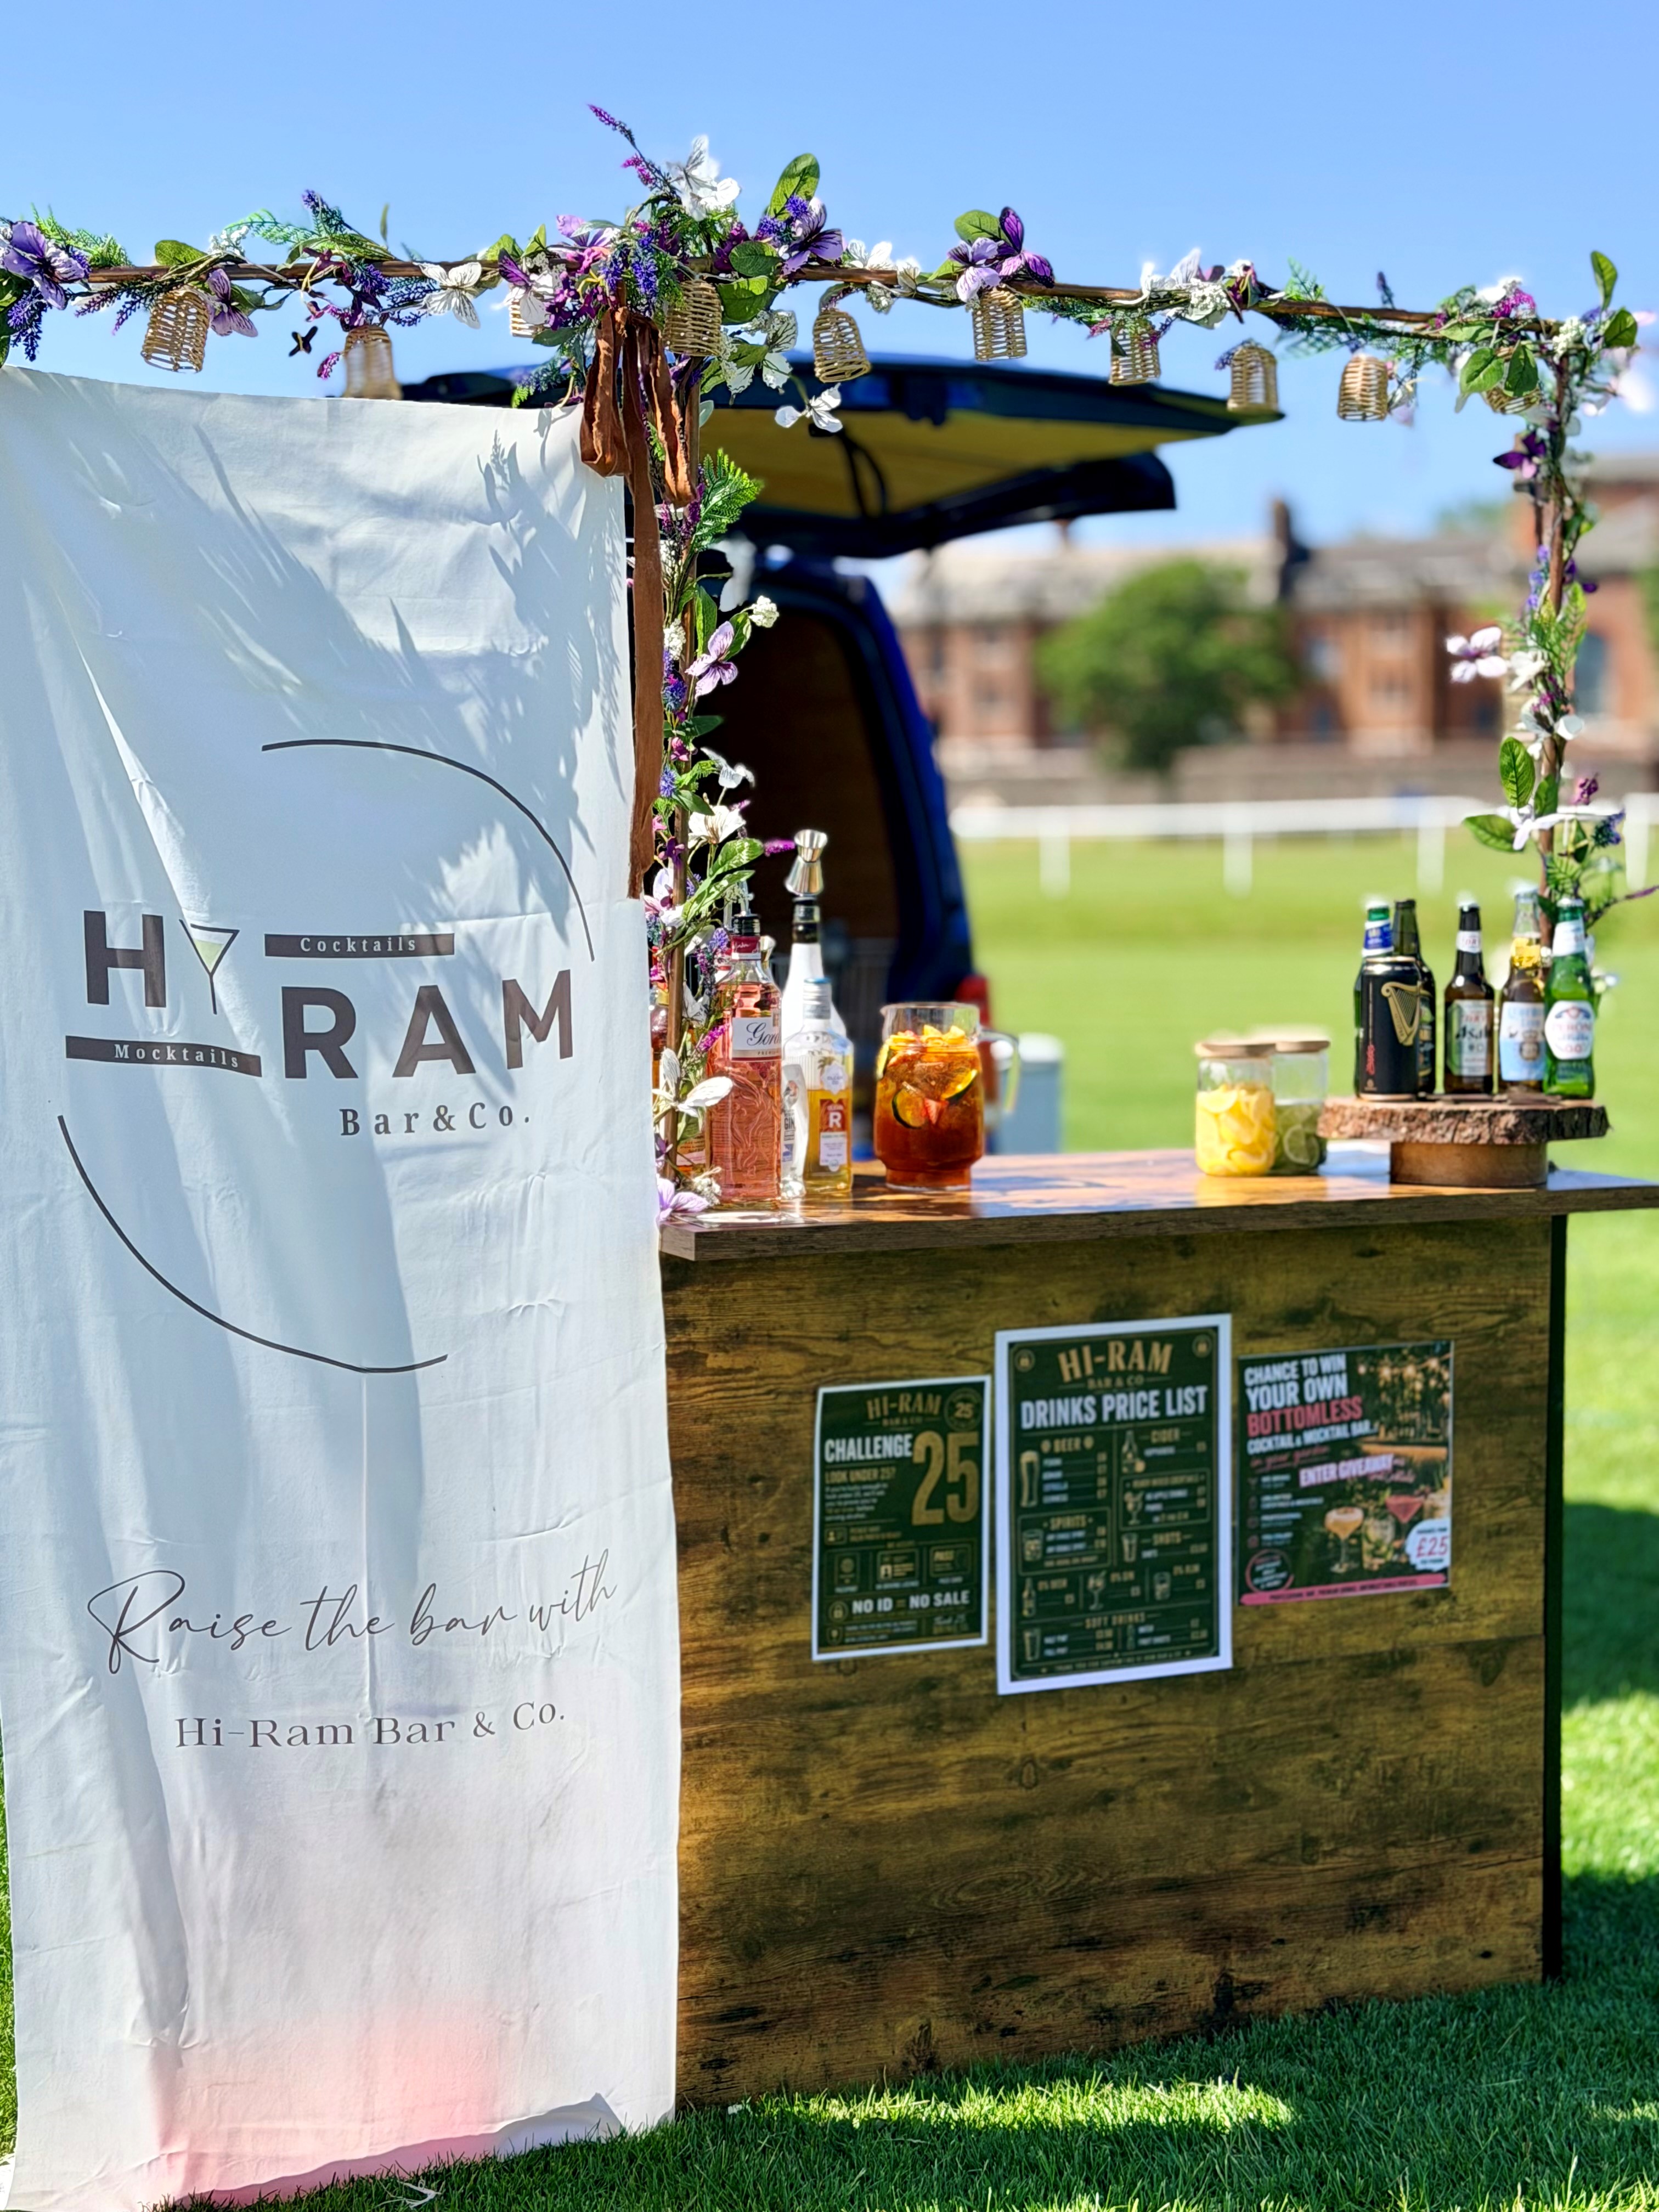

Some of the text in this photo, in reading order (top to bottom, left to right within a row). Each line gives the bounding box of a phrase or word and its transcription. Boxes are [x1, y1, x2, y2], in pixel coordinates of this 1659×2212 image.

[300, 935, 417, 953] Cocktails
[114, 1043, 240, 1068] Mocktails
[784, 1116, 795, 1130] GIN
[829, 1111, 842, 1128] R
[1058, 1340, 1173, 1384] HI-RAM
[1244, 1353, 1347, 1387] CHANCE TO WIN
[1087, 1375, 1144, 1390] BAR & CO
[1246, 1373, 1348, 1413] YOUR OWN
[866, 1392, 943, 1420] HI-RAM
[954, 1402, 974, 1418] 25
[1021, 1385, 1209, 1430] DRINKS PRICE LIST
[1246, 1395, 1363, 1437] BOTTOMLESS
[1151, 1427, 1180, 1443] CIDER
[1246, 1433, 1295, 1455] COCKTAIL
[824, 1433, 913, 1463] CHALLENGE
[911, 1430, 980, 1526] 25
[849, 1467, 879, 1482] UNDER
[1299, 1462, 1338, 1488] ENTER
[1338, 1453, 1395, 1480] GIVEAWAY
[1049, 1514, 1087, 1531] SPIRITS
[1416, 1536, 1448, 1558] £25
[87, 1548, 618, 1675] Raise the bar with
[852, 1599, 874, 1614] NO
[877, 1597, 893, 1611] ID
[909, 1594, 930, 1609] NO
[933, 1590, 970, 1607] SALE
[176, 1701, 566, 1748] Hi-Ram Bar & Co.
